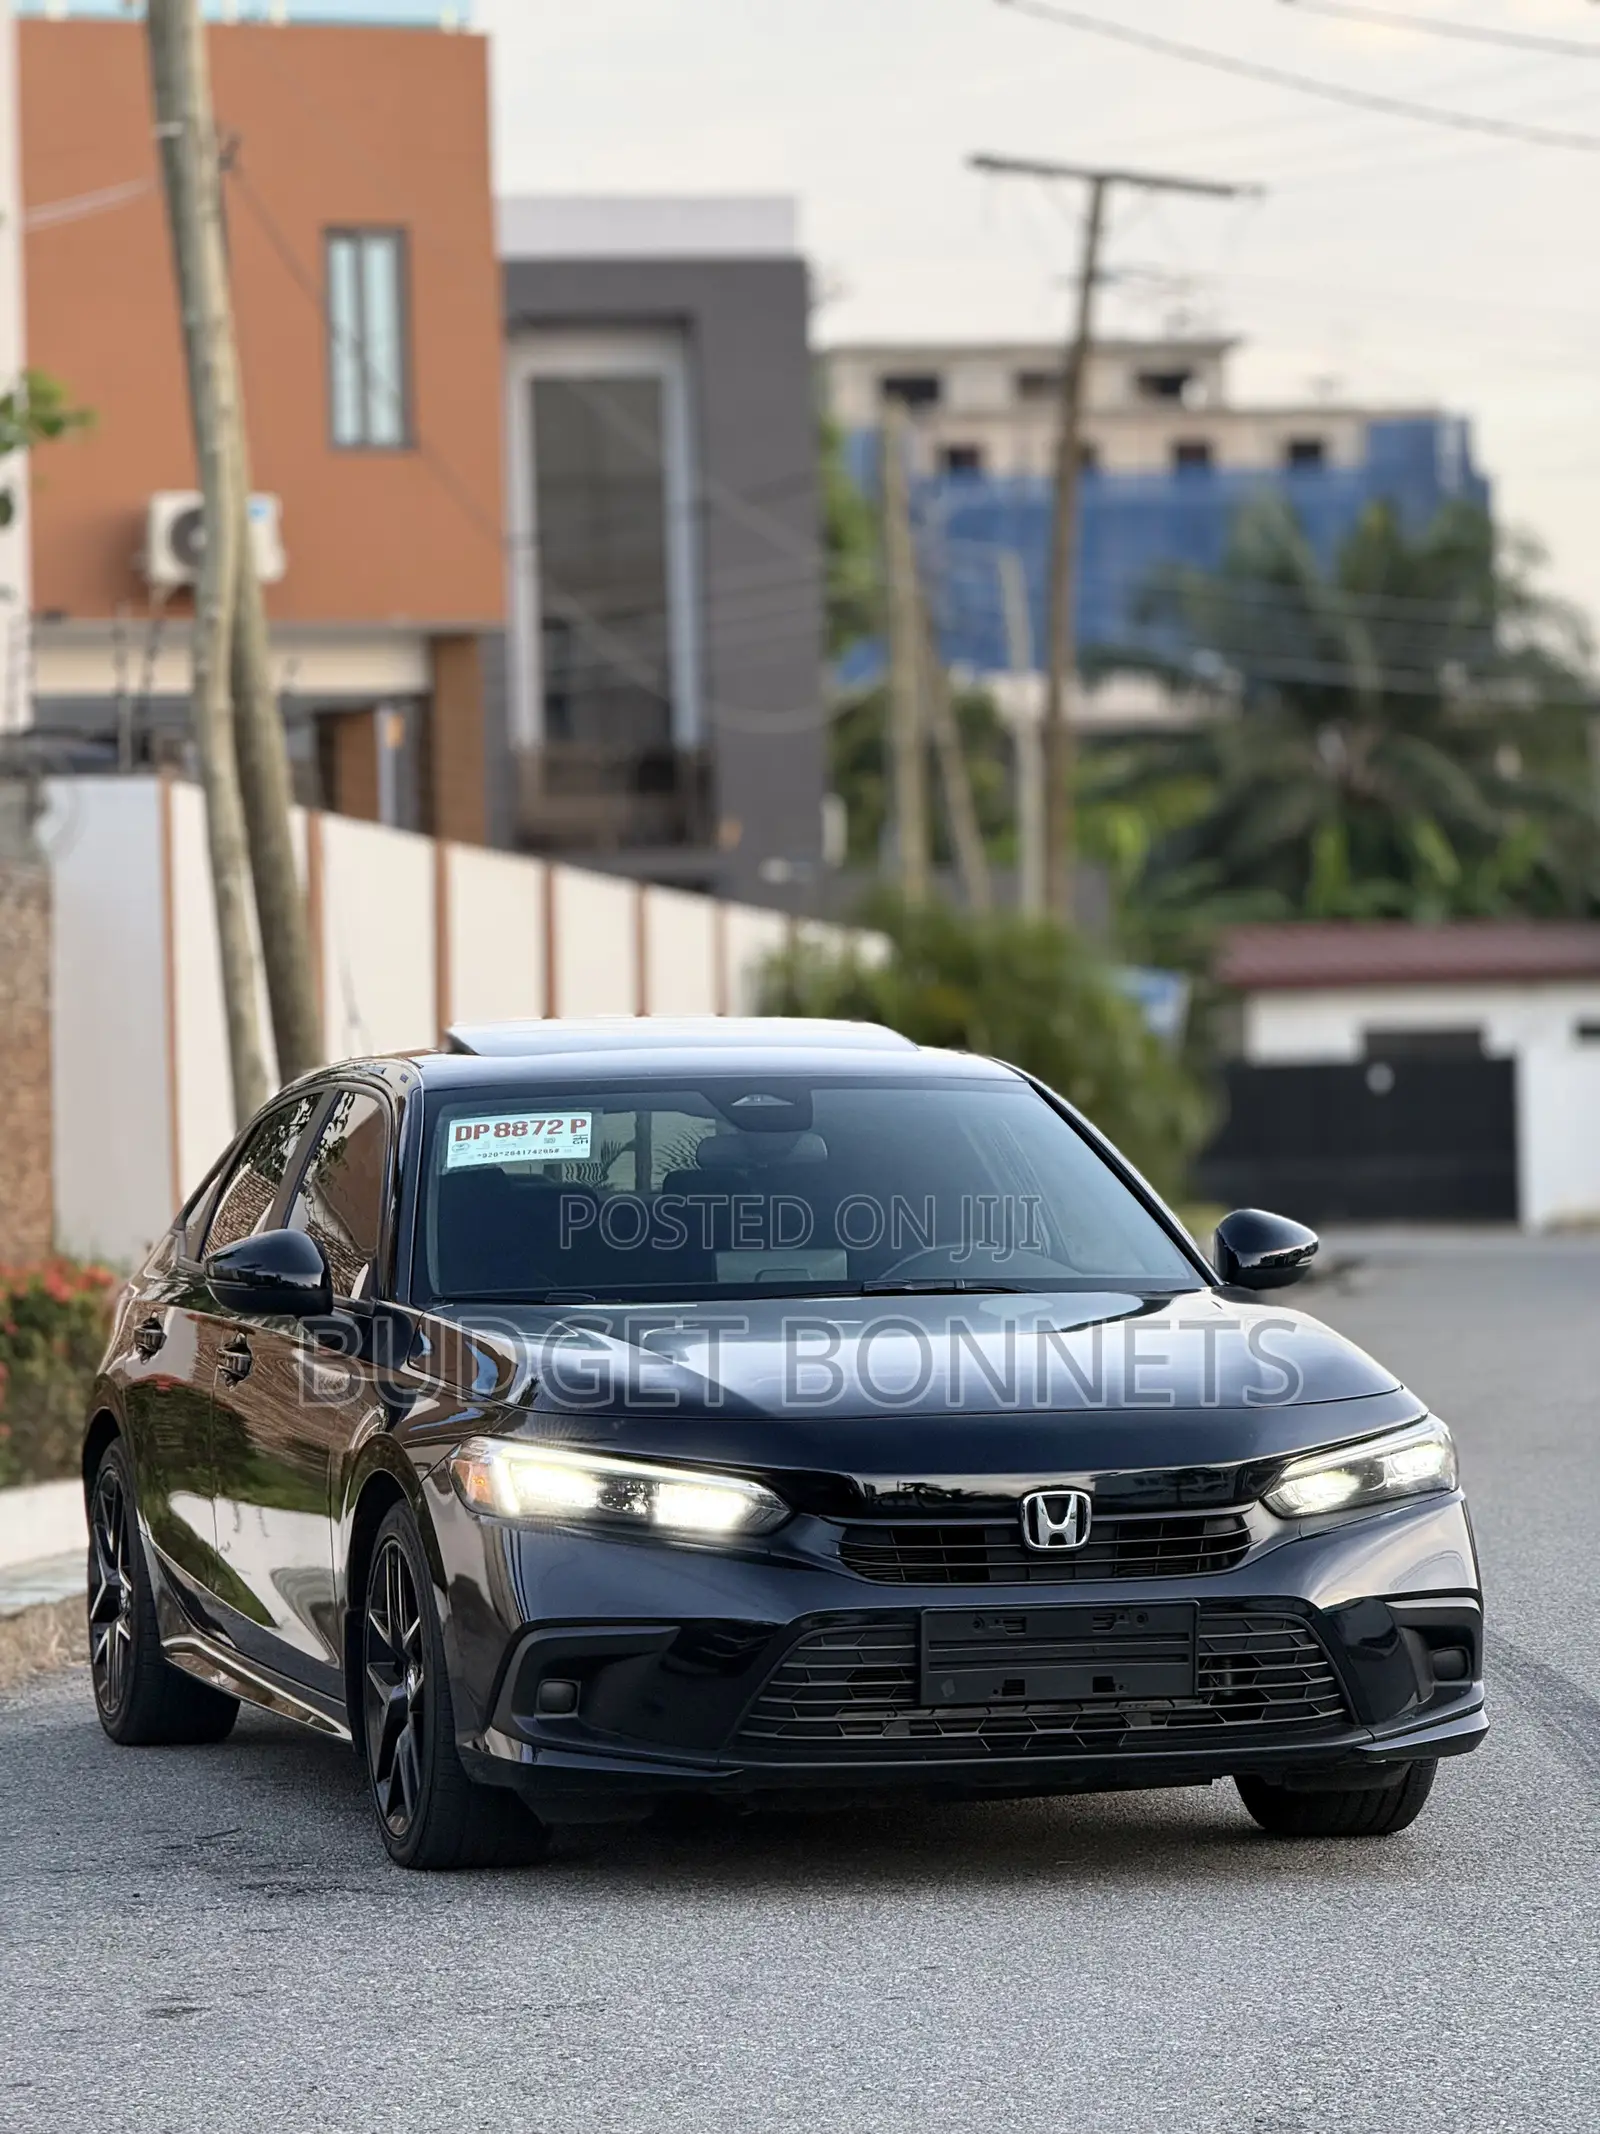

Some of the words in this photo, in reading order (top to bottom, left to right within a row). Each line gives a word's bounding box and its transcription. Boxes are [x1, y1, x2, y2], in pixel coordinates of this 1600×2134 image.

[455, 1124, 490, 1142] DP
[493, 1119, 564, 1138] 8872
[570, 1118, 587, 1134] P
